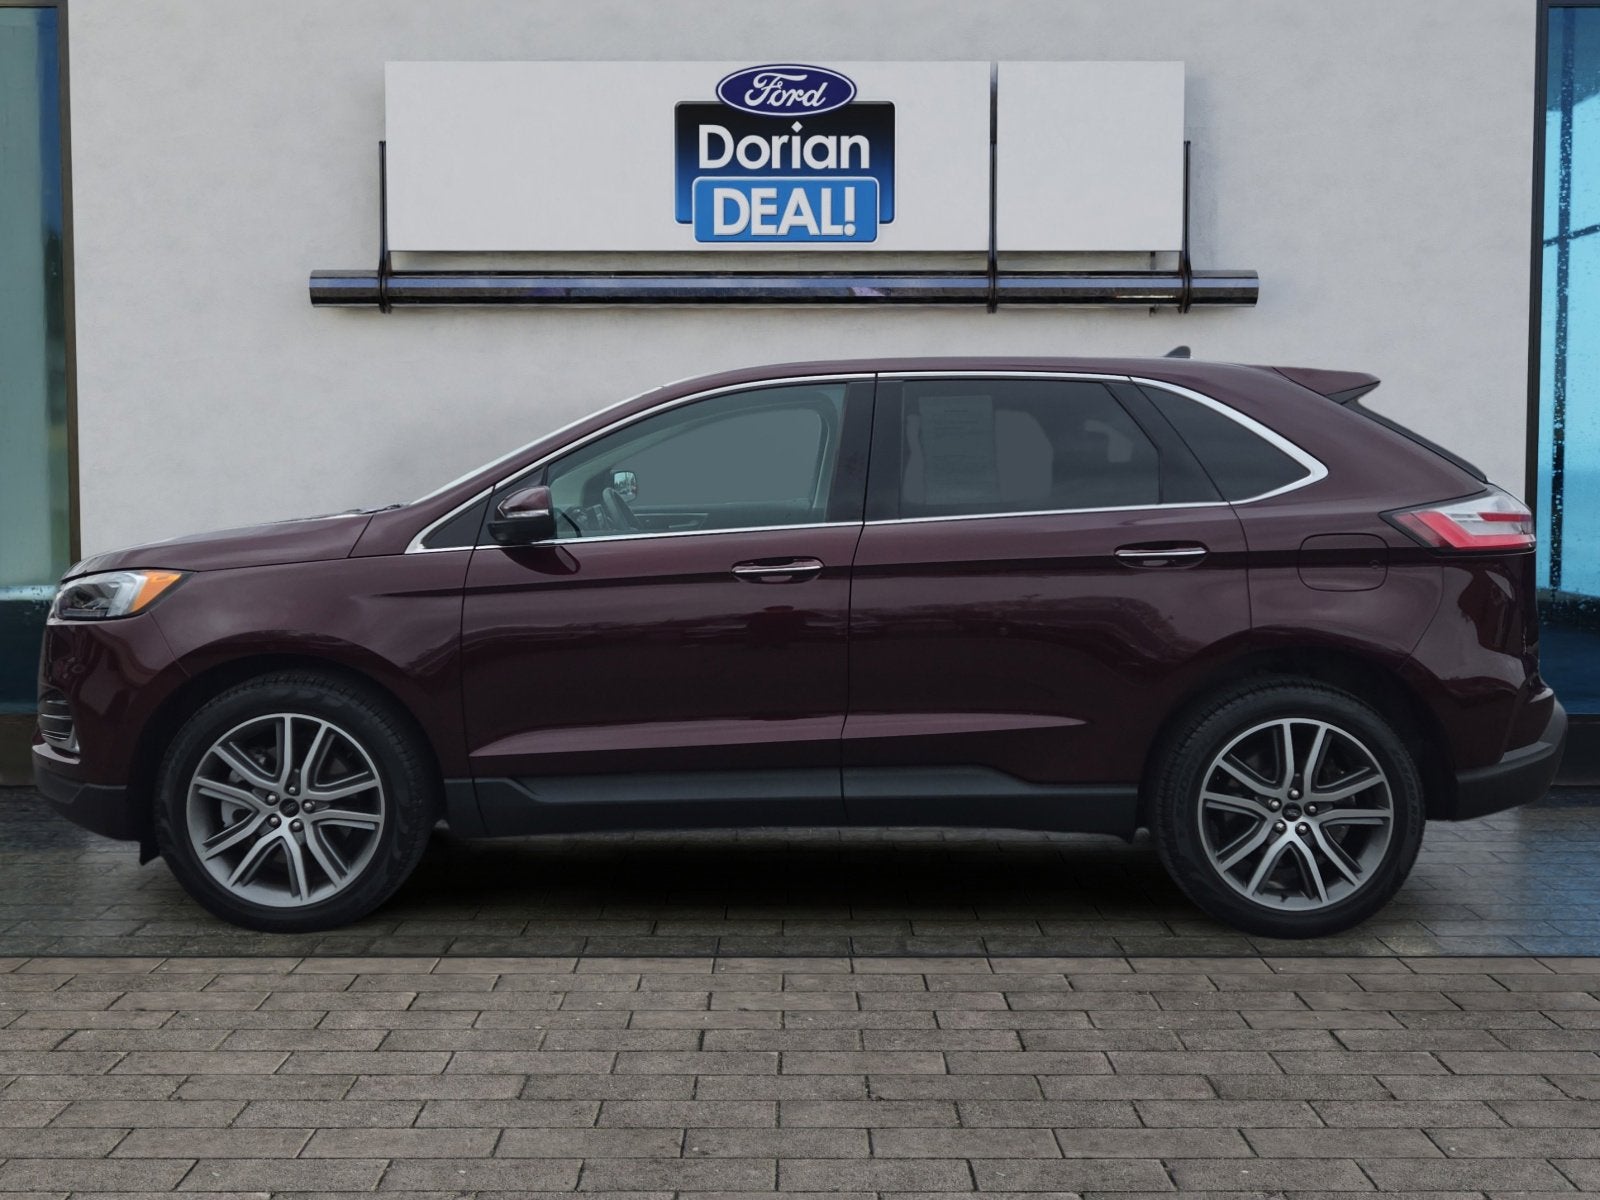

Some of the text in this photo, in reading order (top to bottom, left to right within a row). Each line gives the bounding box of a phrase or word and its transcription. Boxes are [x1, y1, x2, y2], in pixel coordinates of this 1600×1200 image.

[744, 72, 828, 107] Ford
[699, 121, 870, 169] Dorian
[713, 187, 856, 237] DEAL!
